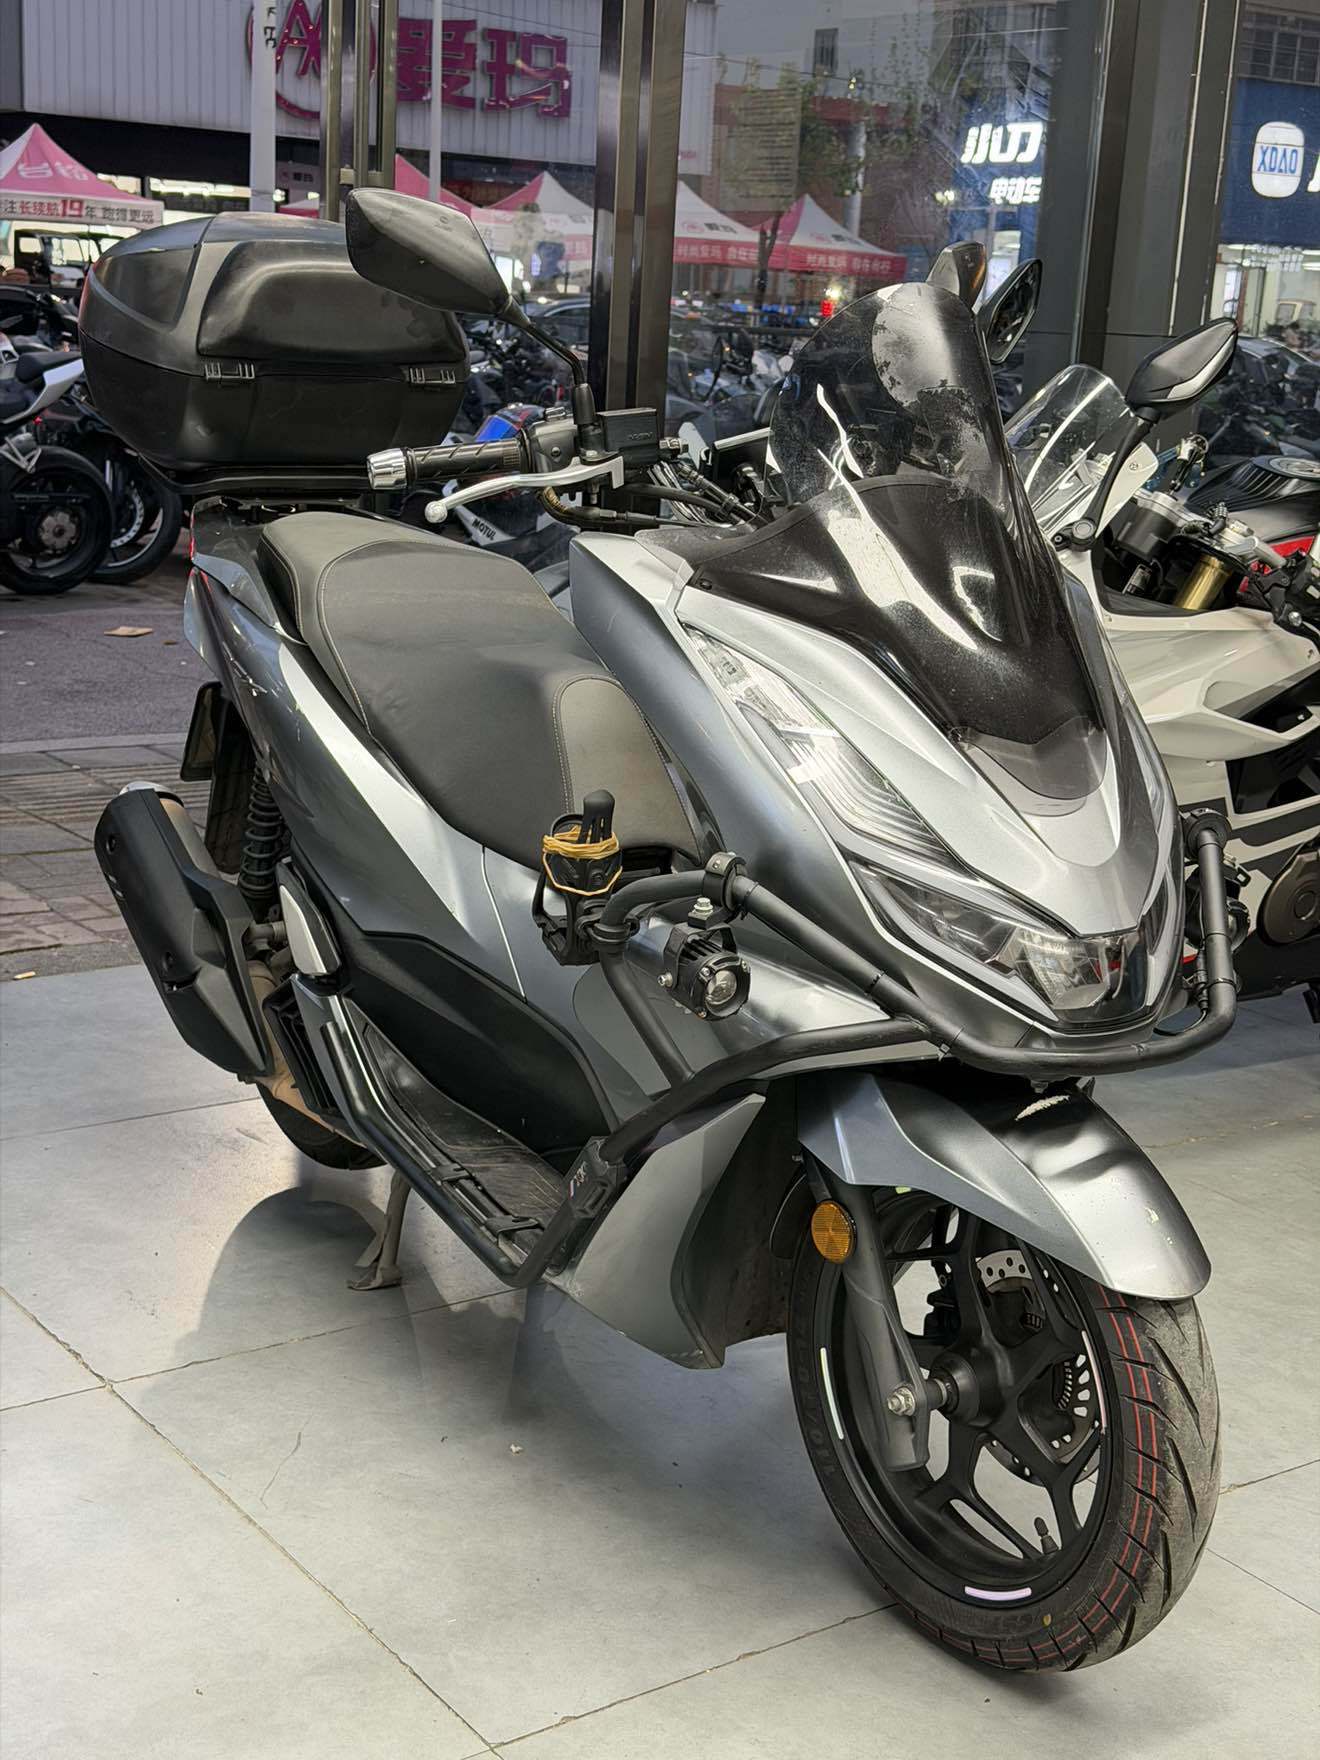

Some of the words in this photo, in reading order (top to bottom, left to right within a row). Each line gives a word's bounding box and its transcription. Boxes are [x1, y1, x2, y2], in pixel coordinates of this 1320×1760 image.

[396, 17, 571, 119] 爱玛
[960, 122, 1044, 164] 小刀
[471, 517, 497, 541] MOTUL
